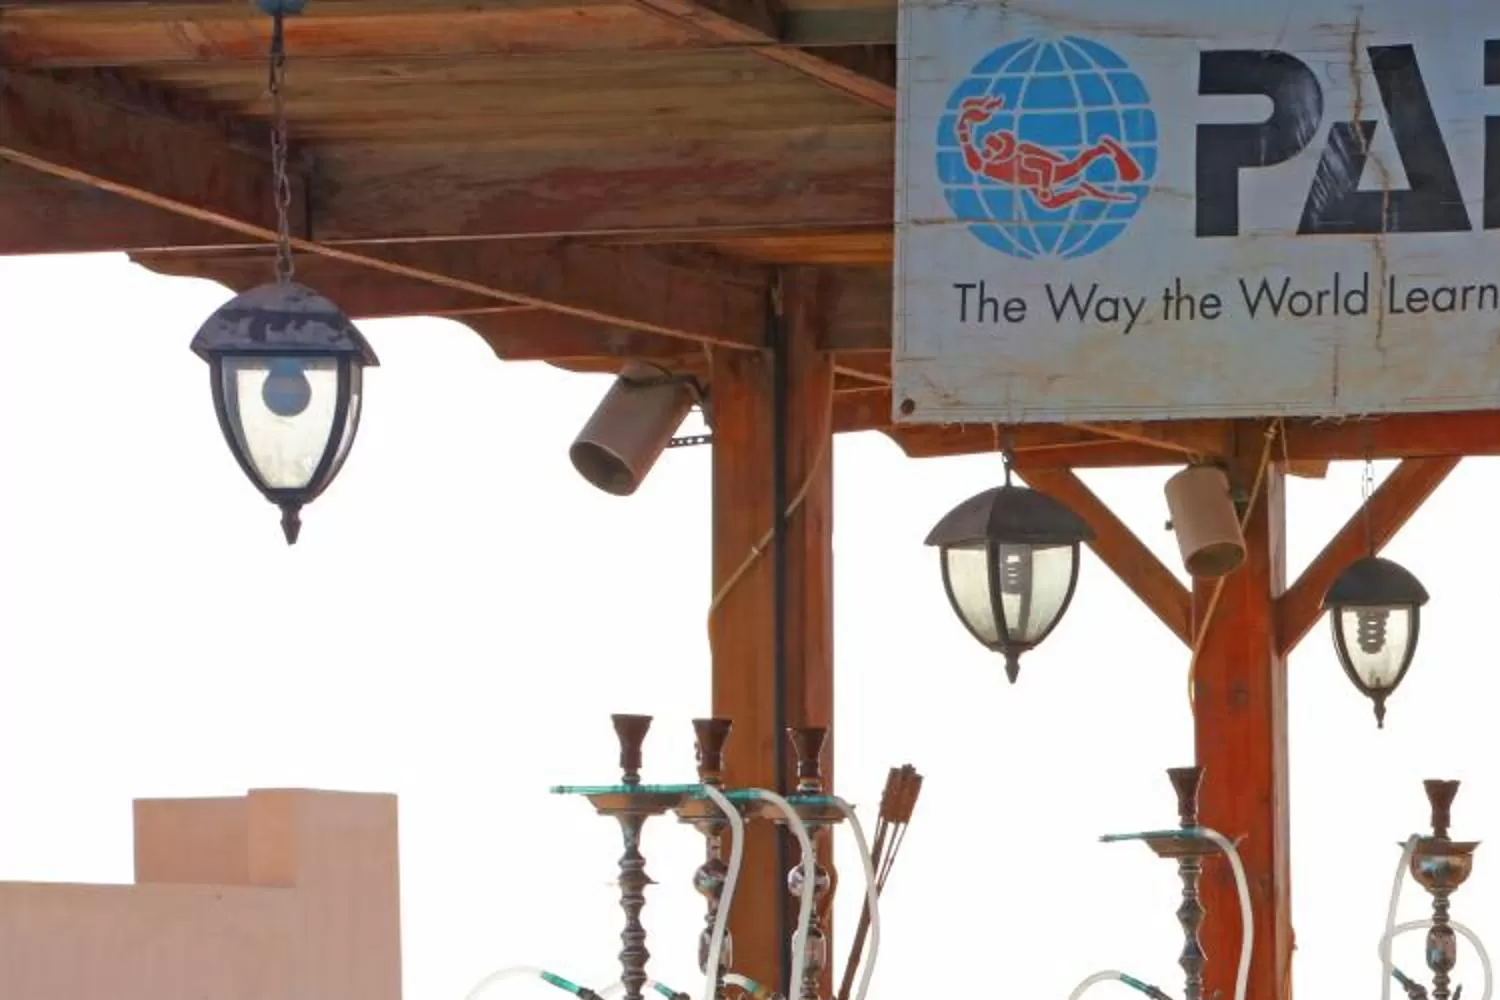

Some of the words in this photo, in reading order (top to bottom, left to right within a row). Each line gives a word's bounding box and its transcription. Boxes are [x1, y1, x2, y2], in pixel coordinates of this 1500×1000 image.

[953, 280, 1027, 323] The
[1045, 283, 1146, 334] Way
[1161, 277, 1222, 321] the
[1239, 272, 1369, 319] World
